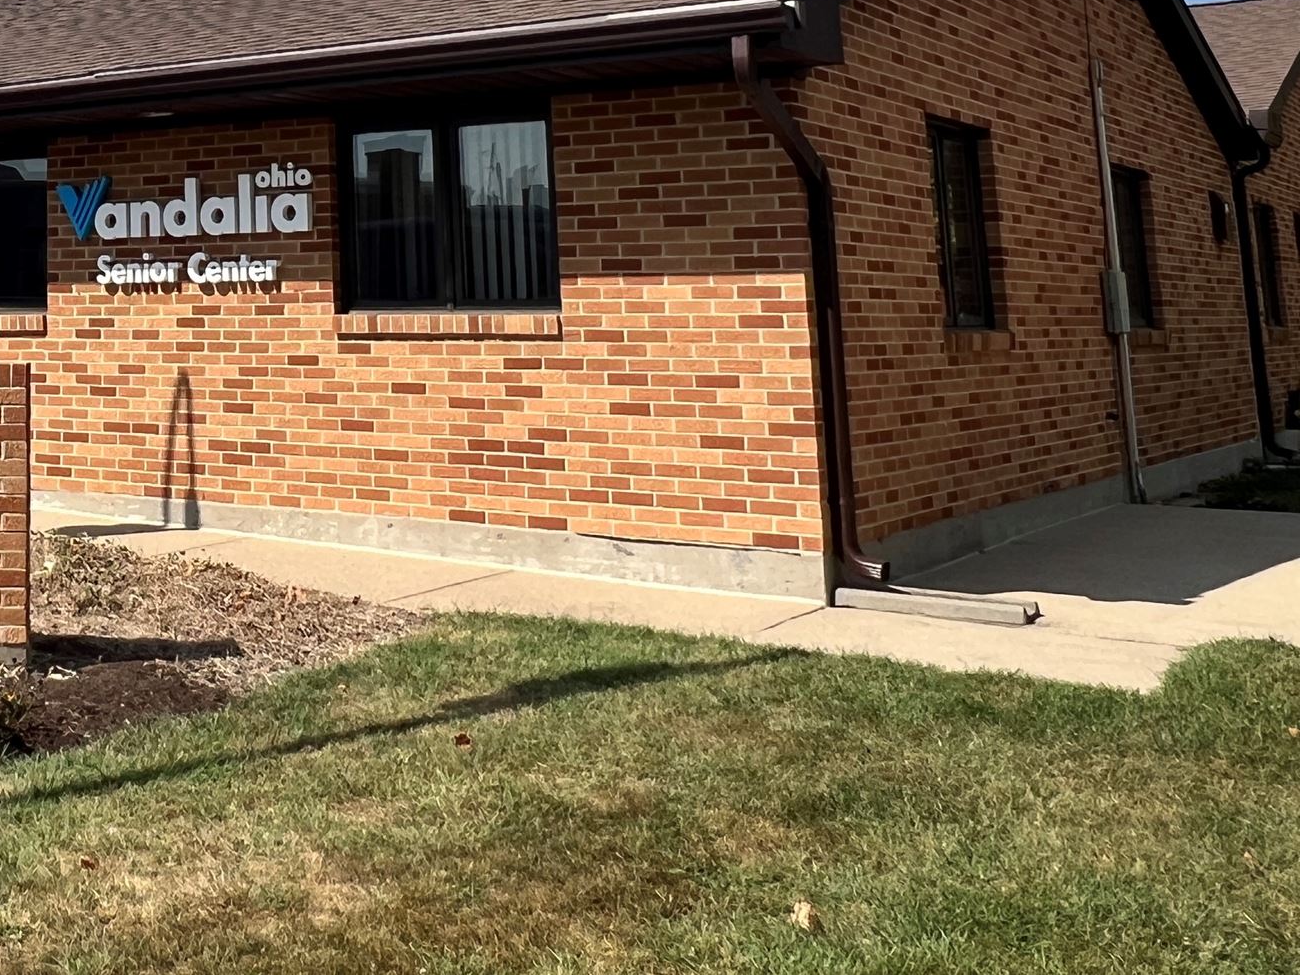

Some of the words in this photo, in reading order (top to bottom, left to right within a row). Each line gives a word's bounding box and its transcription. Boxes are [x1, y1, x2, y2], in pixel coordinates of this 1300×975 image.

[255, 162, 312, 188] ohio
[56, 173, 311, 241] Vandalia
[96, 253, 180, 284] Senior
[187, 252, 279, 283] Center
